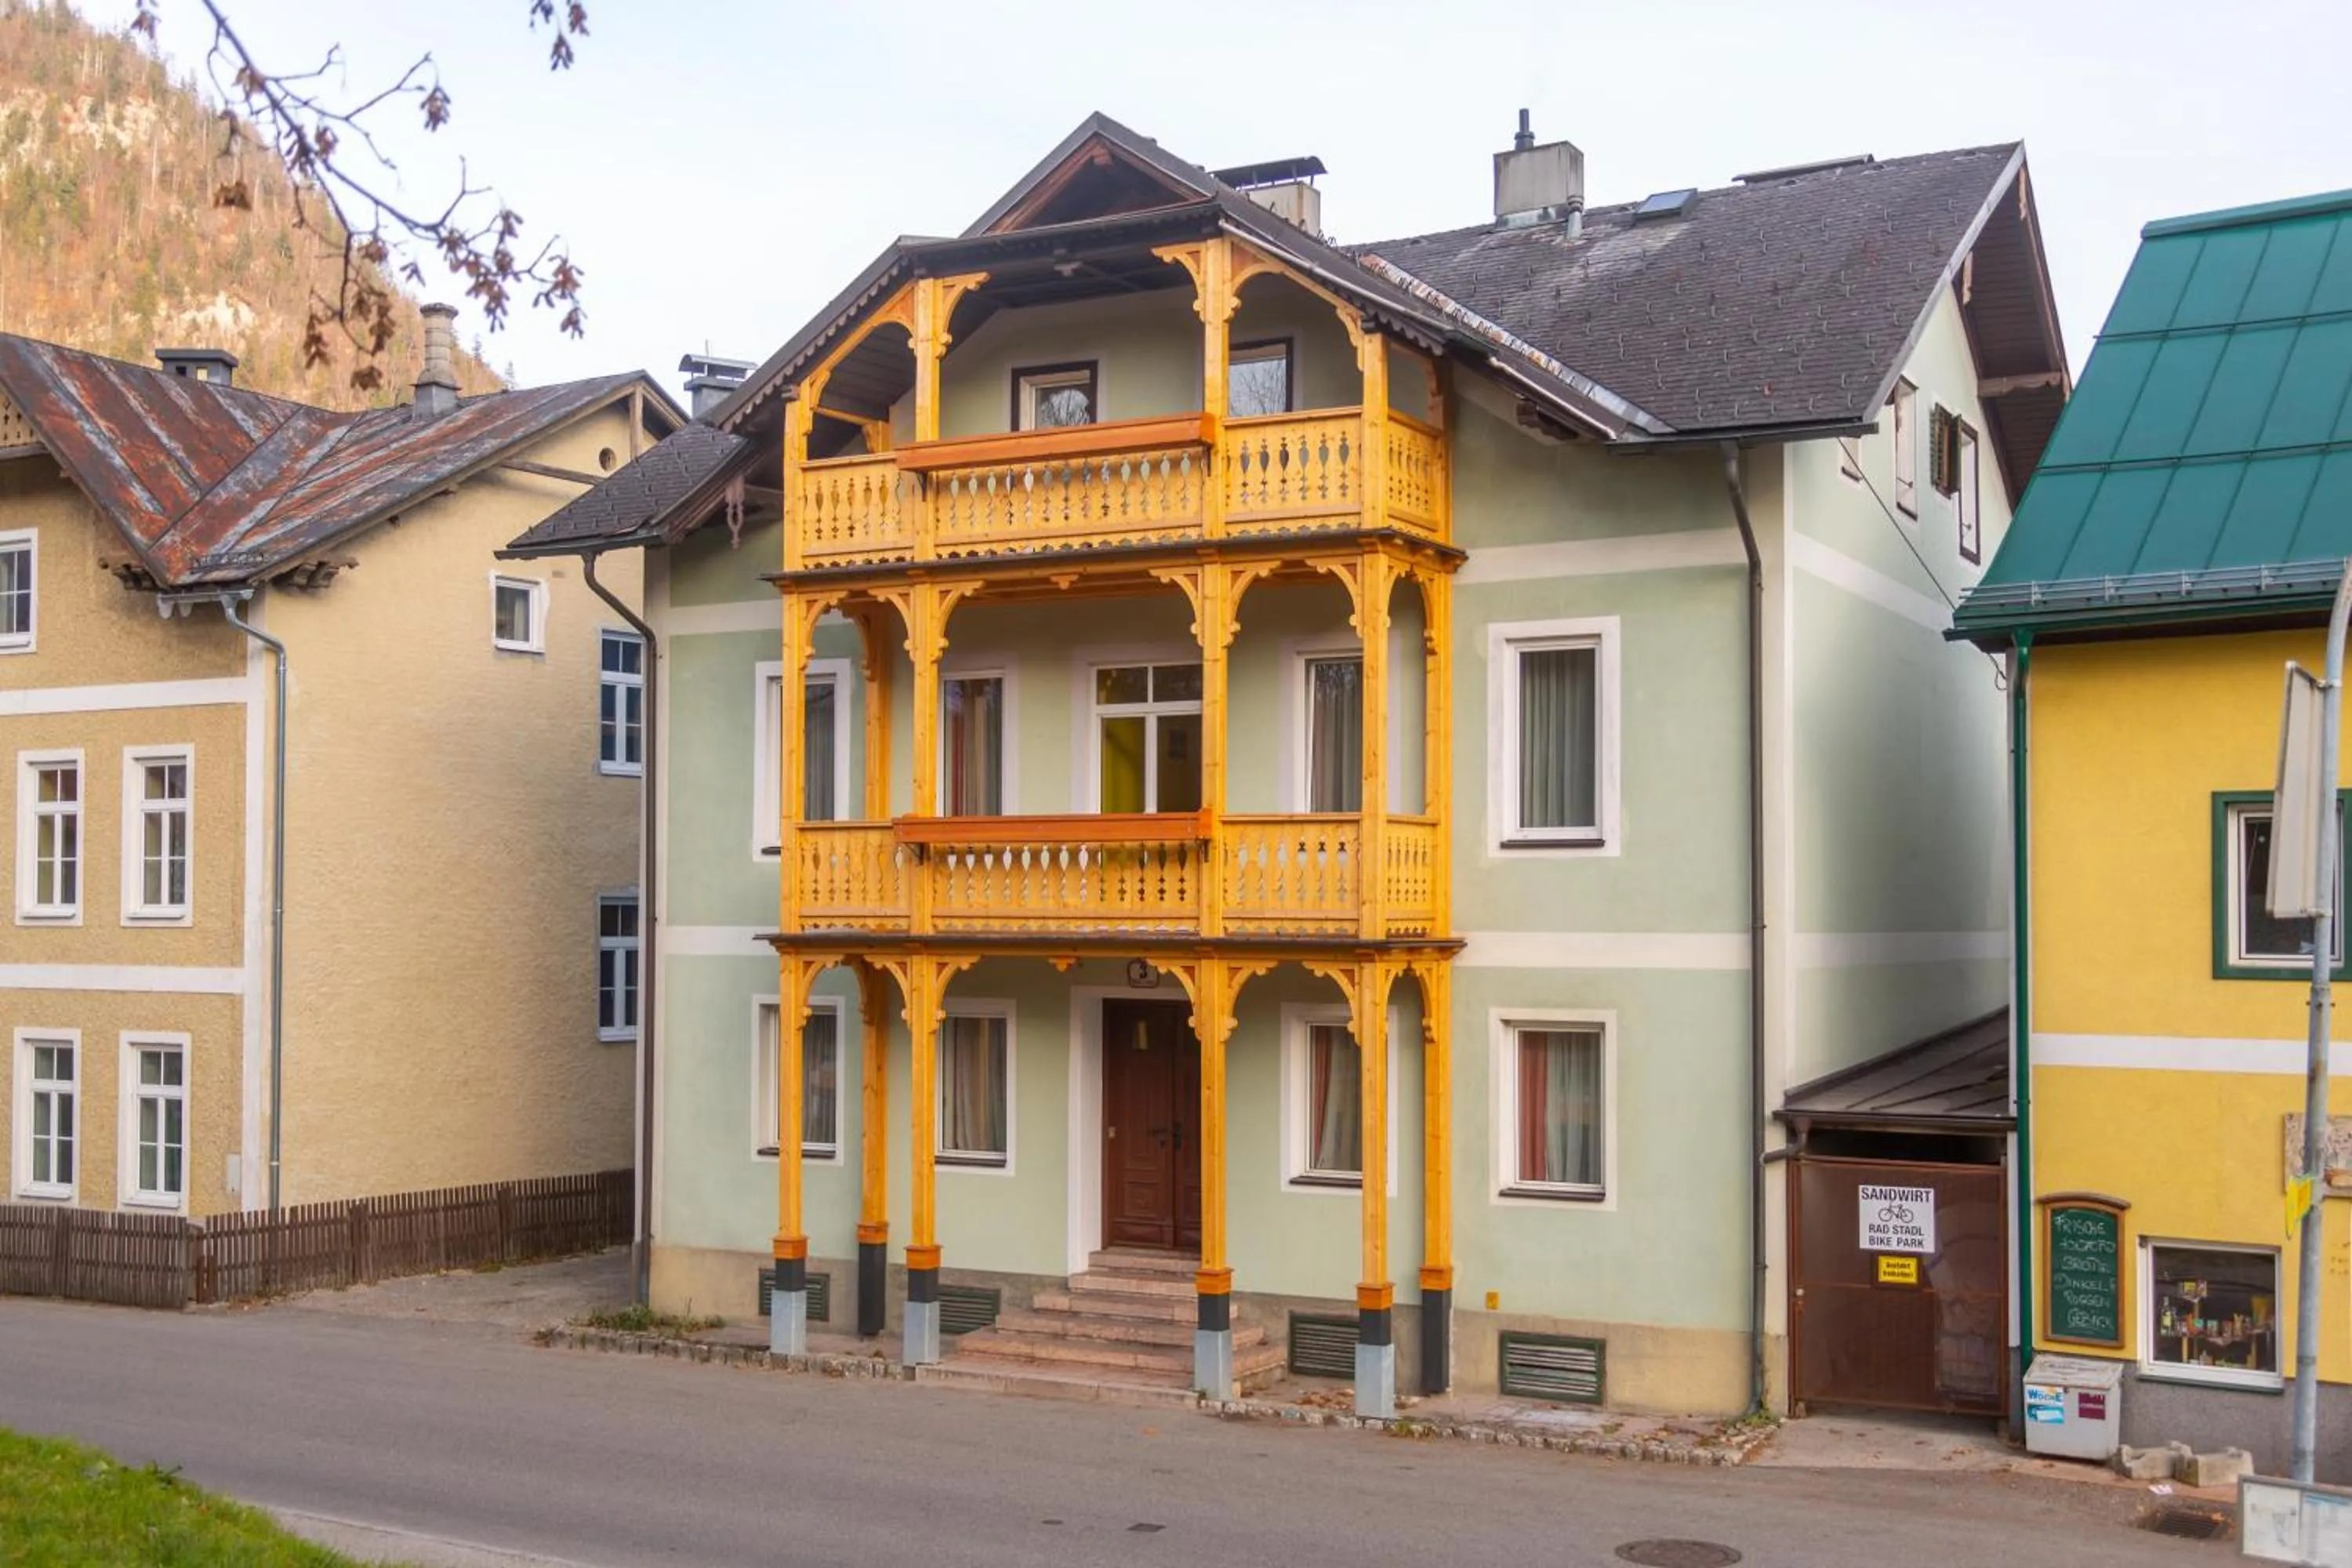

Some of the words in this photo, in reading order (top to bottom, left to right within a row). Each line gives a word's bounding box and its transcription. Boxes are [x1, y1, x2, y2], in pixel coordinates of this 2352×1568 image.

[1861, 1187, 1931, 1203] SANDWIRT
[1869, 1224, 1889, 1235] RAD
[1893, 1225, 1924, 1236] STADL
[1869, 1236, 1893, 1247] BIKE
[1896, 1236, 1925, 1249] PARK
